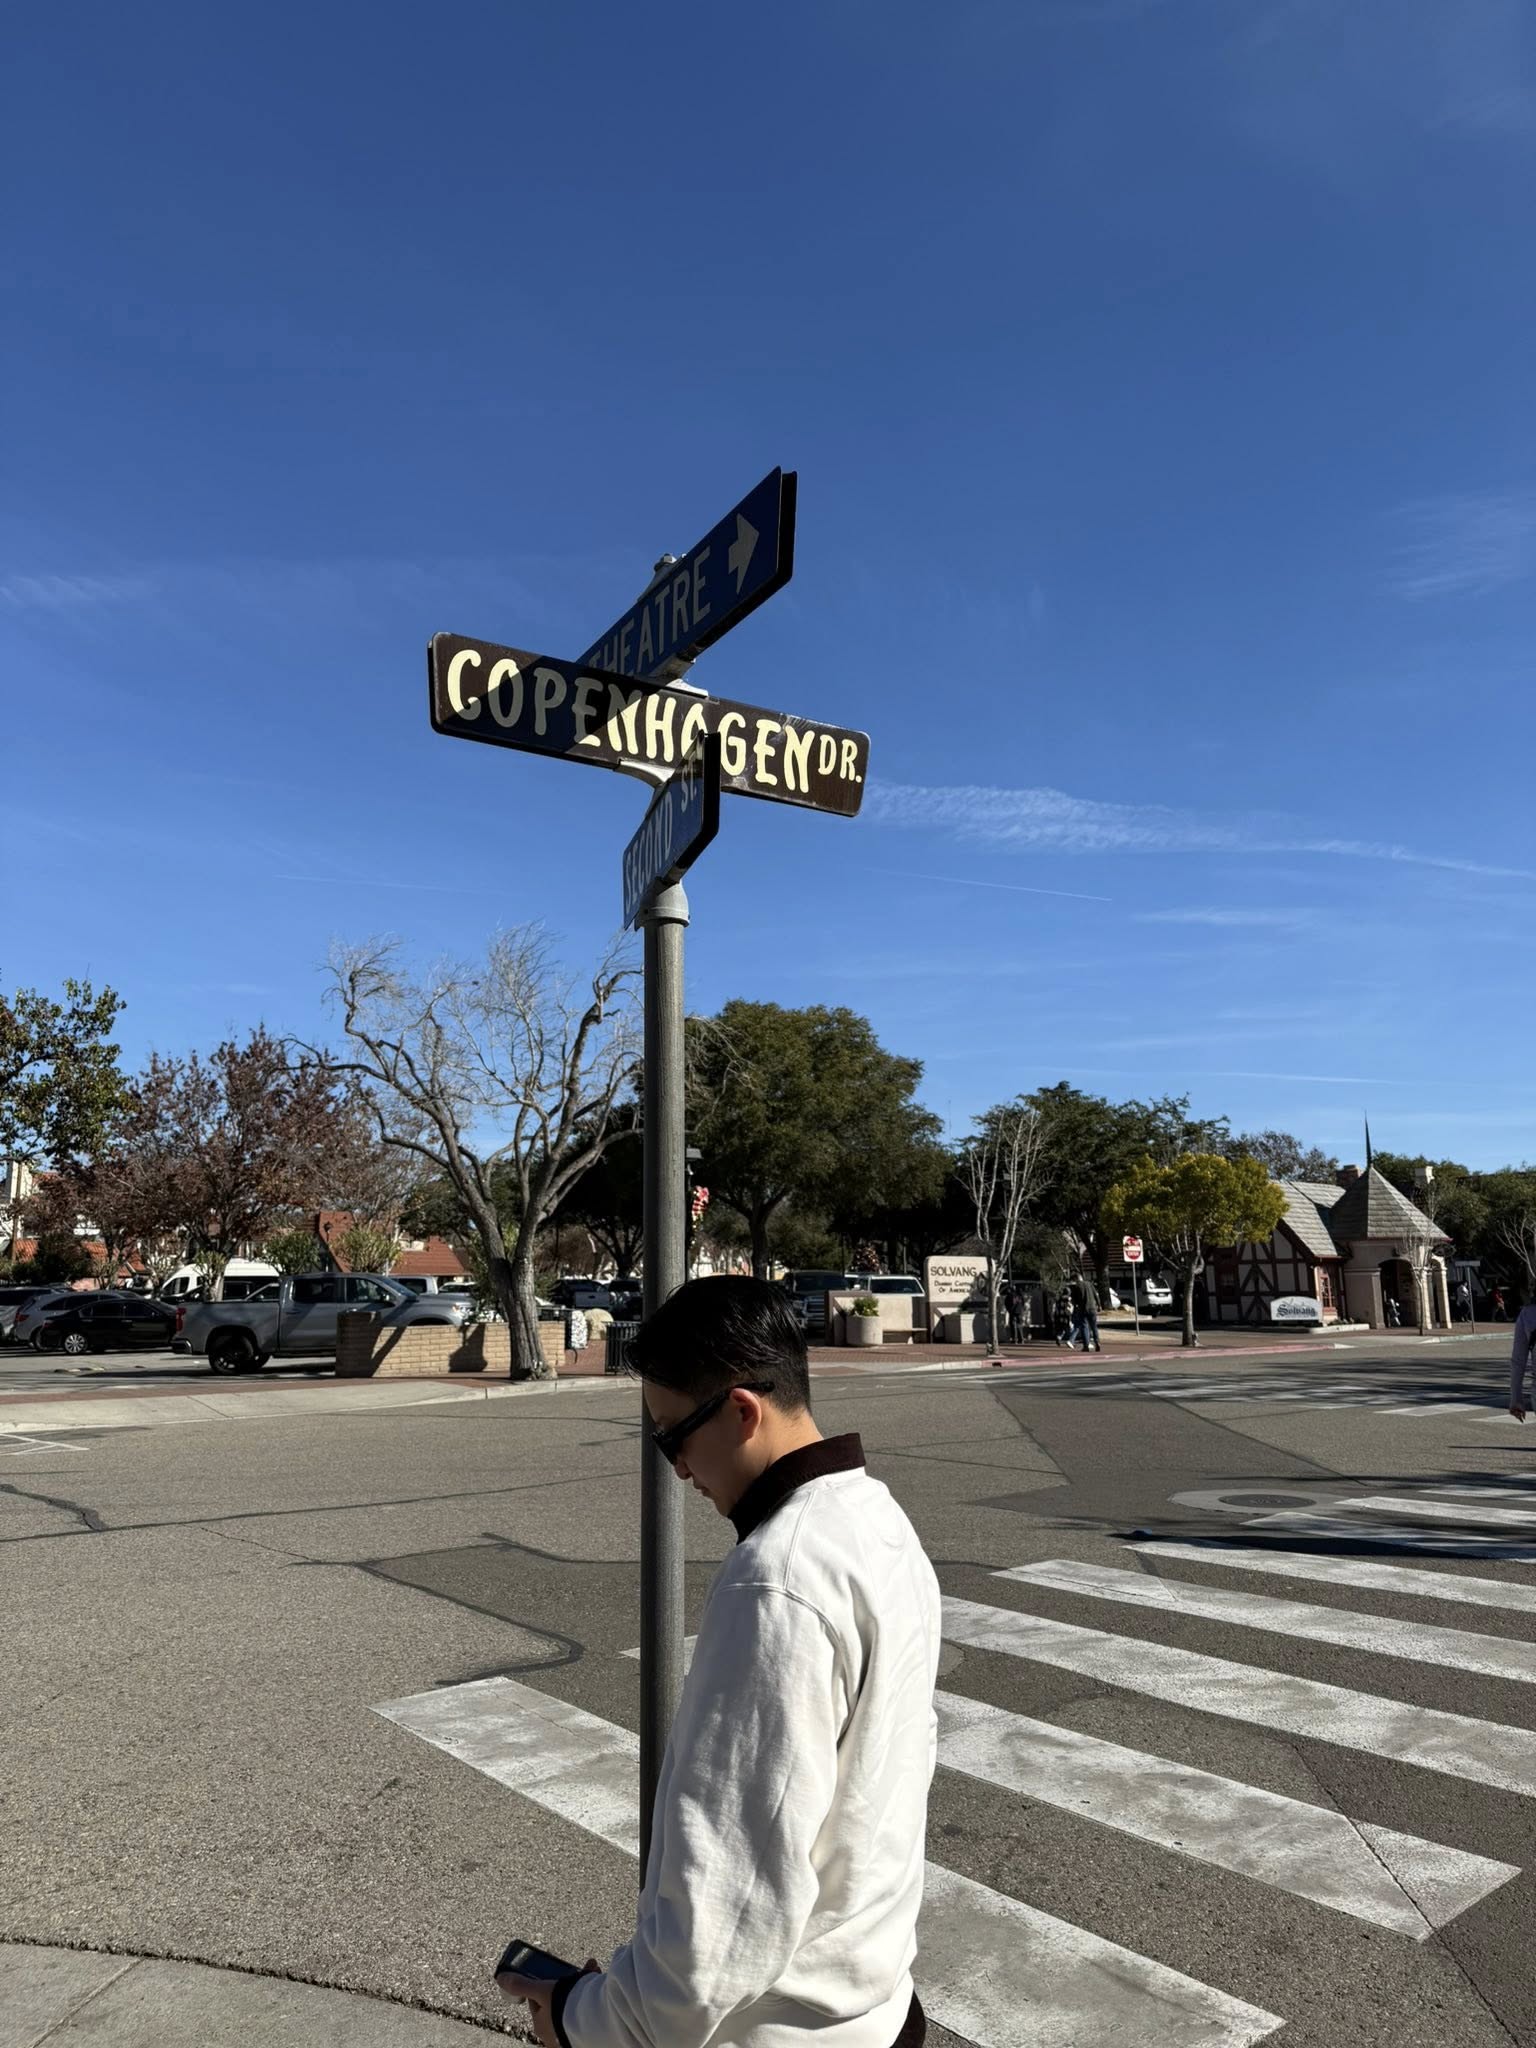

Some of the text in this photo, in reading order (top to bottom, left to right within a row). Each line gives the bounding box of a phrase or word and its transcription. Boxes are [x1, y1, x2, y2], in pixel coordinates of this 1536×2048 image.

[446, 648, 863, 794] COPENHAGEN DR.
[625, 790, 673, 915] SECOND
[930, 1266, 977, 1277] SOLVANG
